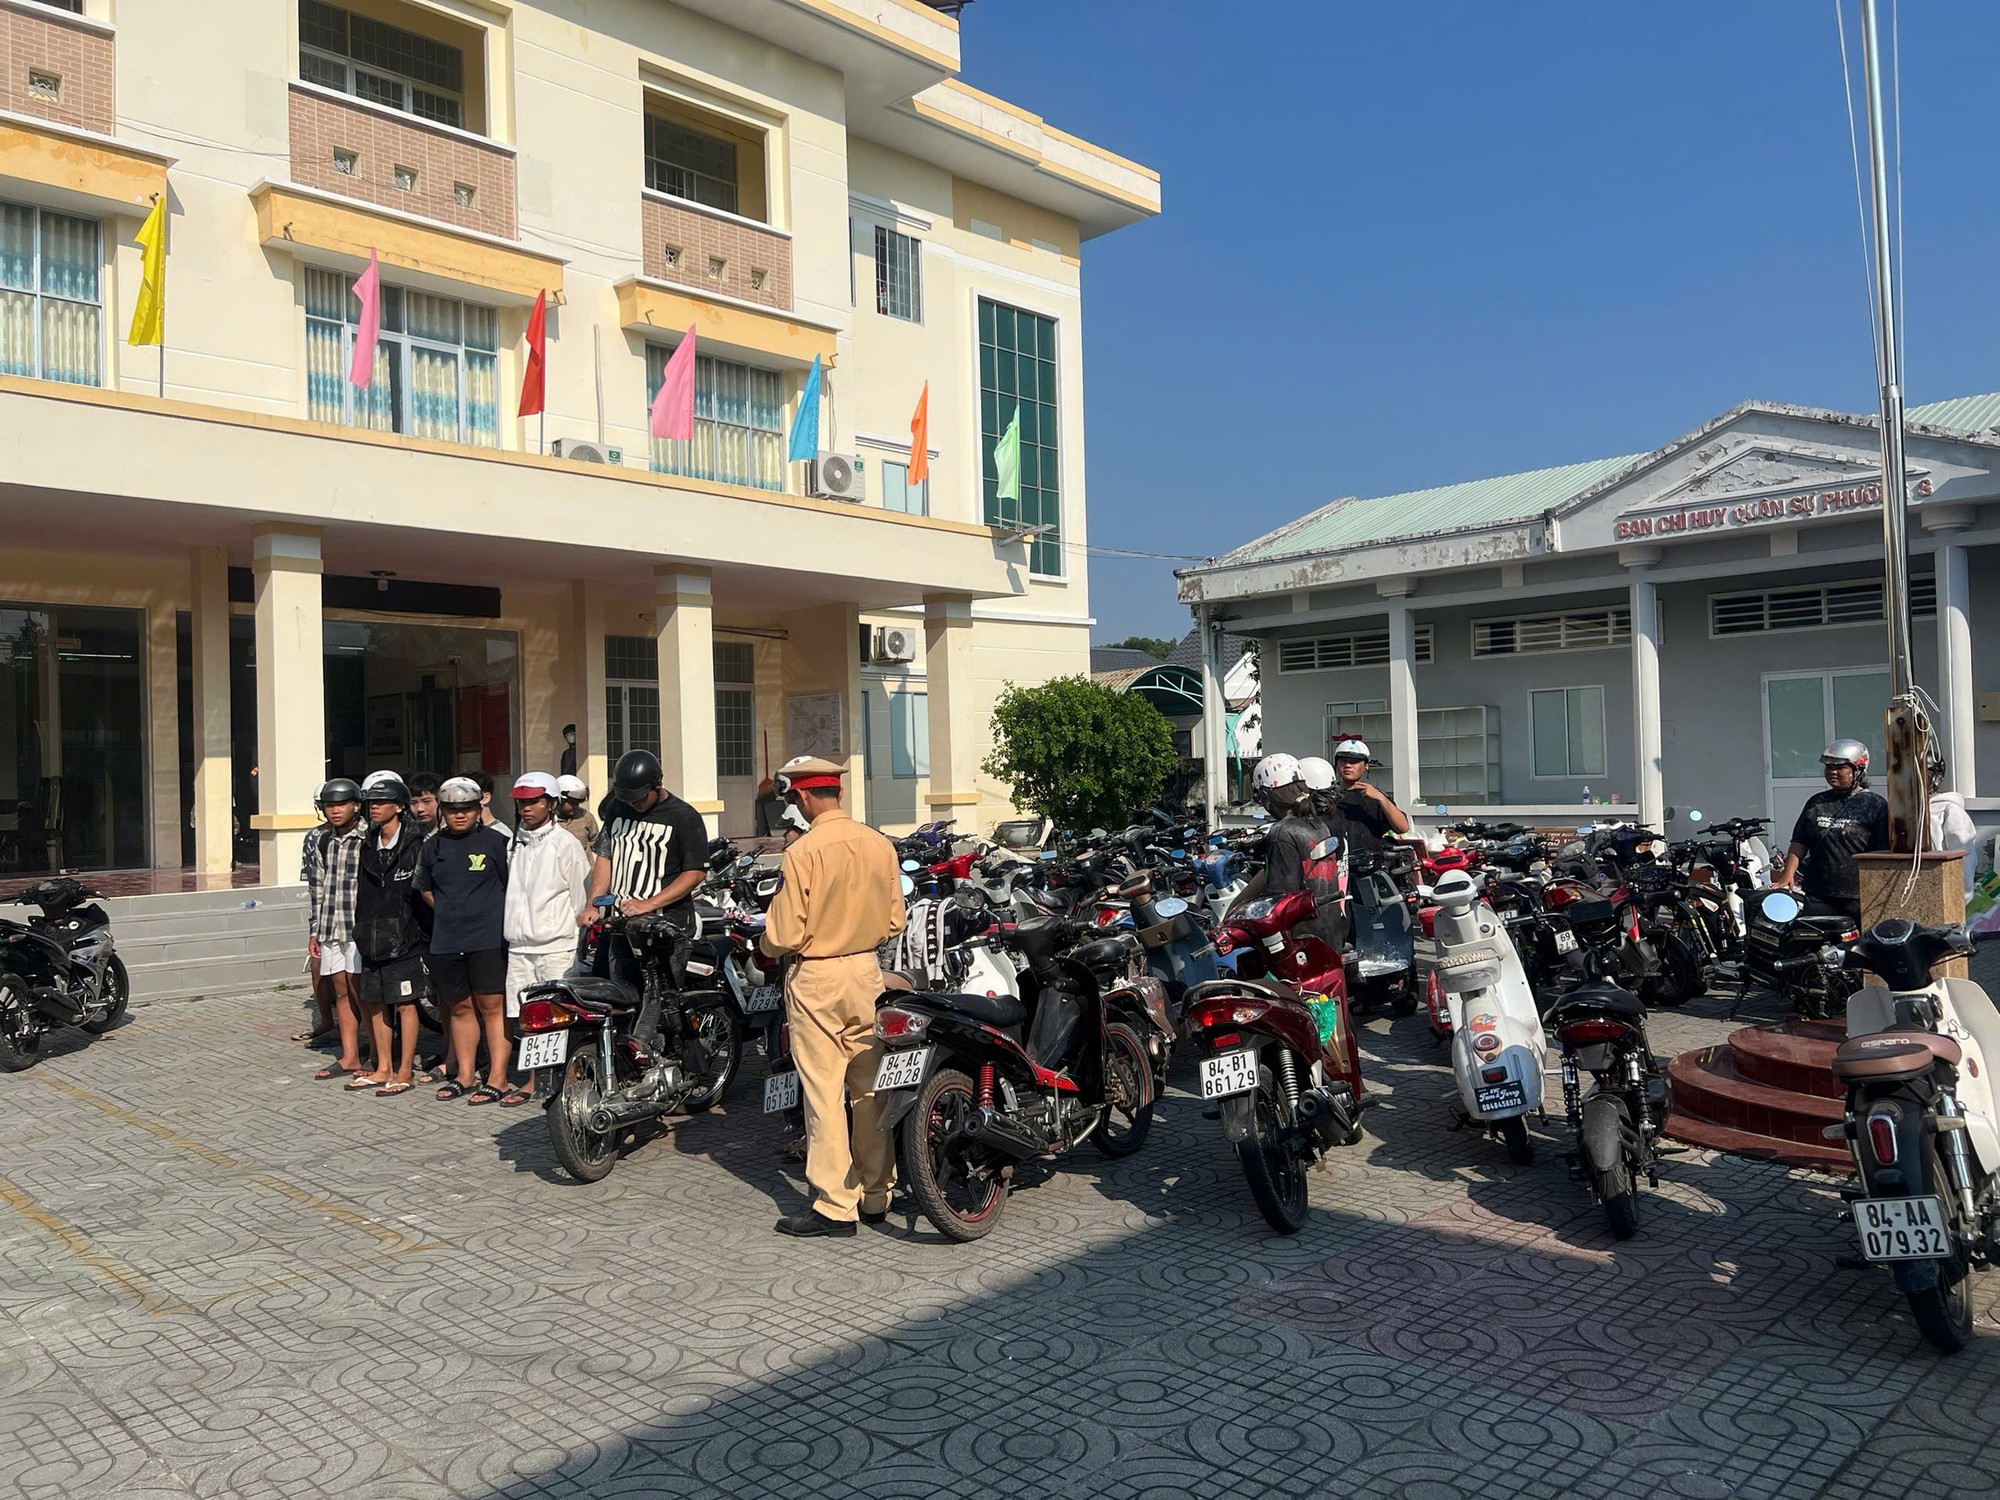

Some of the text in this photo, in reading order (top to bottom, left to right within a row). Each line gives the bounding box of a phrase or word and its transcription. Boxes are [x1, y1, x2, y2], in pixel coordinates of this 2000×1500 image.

[1617, 518, 1653, 539] BAN
[1690, 507, 1727, 529] HUY
[1733, 498, 1786, 524] QUÂN
[1821, 482, 1910, 511] PHƯỜ
[526, 1031, 560, 1052] 84-F7
[524, 1050, 559, 1068] 8345
[886, 1051, 922, 1071] 84-AC
[1208, 1053, 1248, 1078] 84-B1
[769, 1073, 794, 1094] 84-AC
[878, 1067, 921, 1089] 060.28
[1205, 1070, 1256, 1096] 861.29
[766, 1090, 796, 1112] 051.30
[1866, 1200, 1932, 1229] 84-AA
[1866, 1228, 1945, 1256] 079.32
